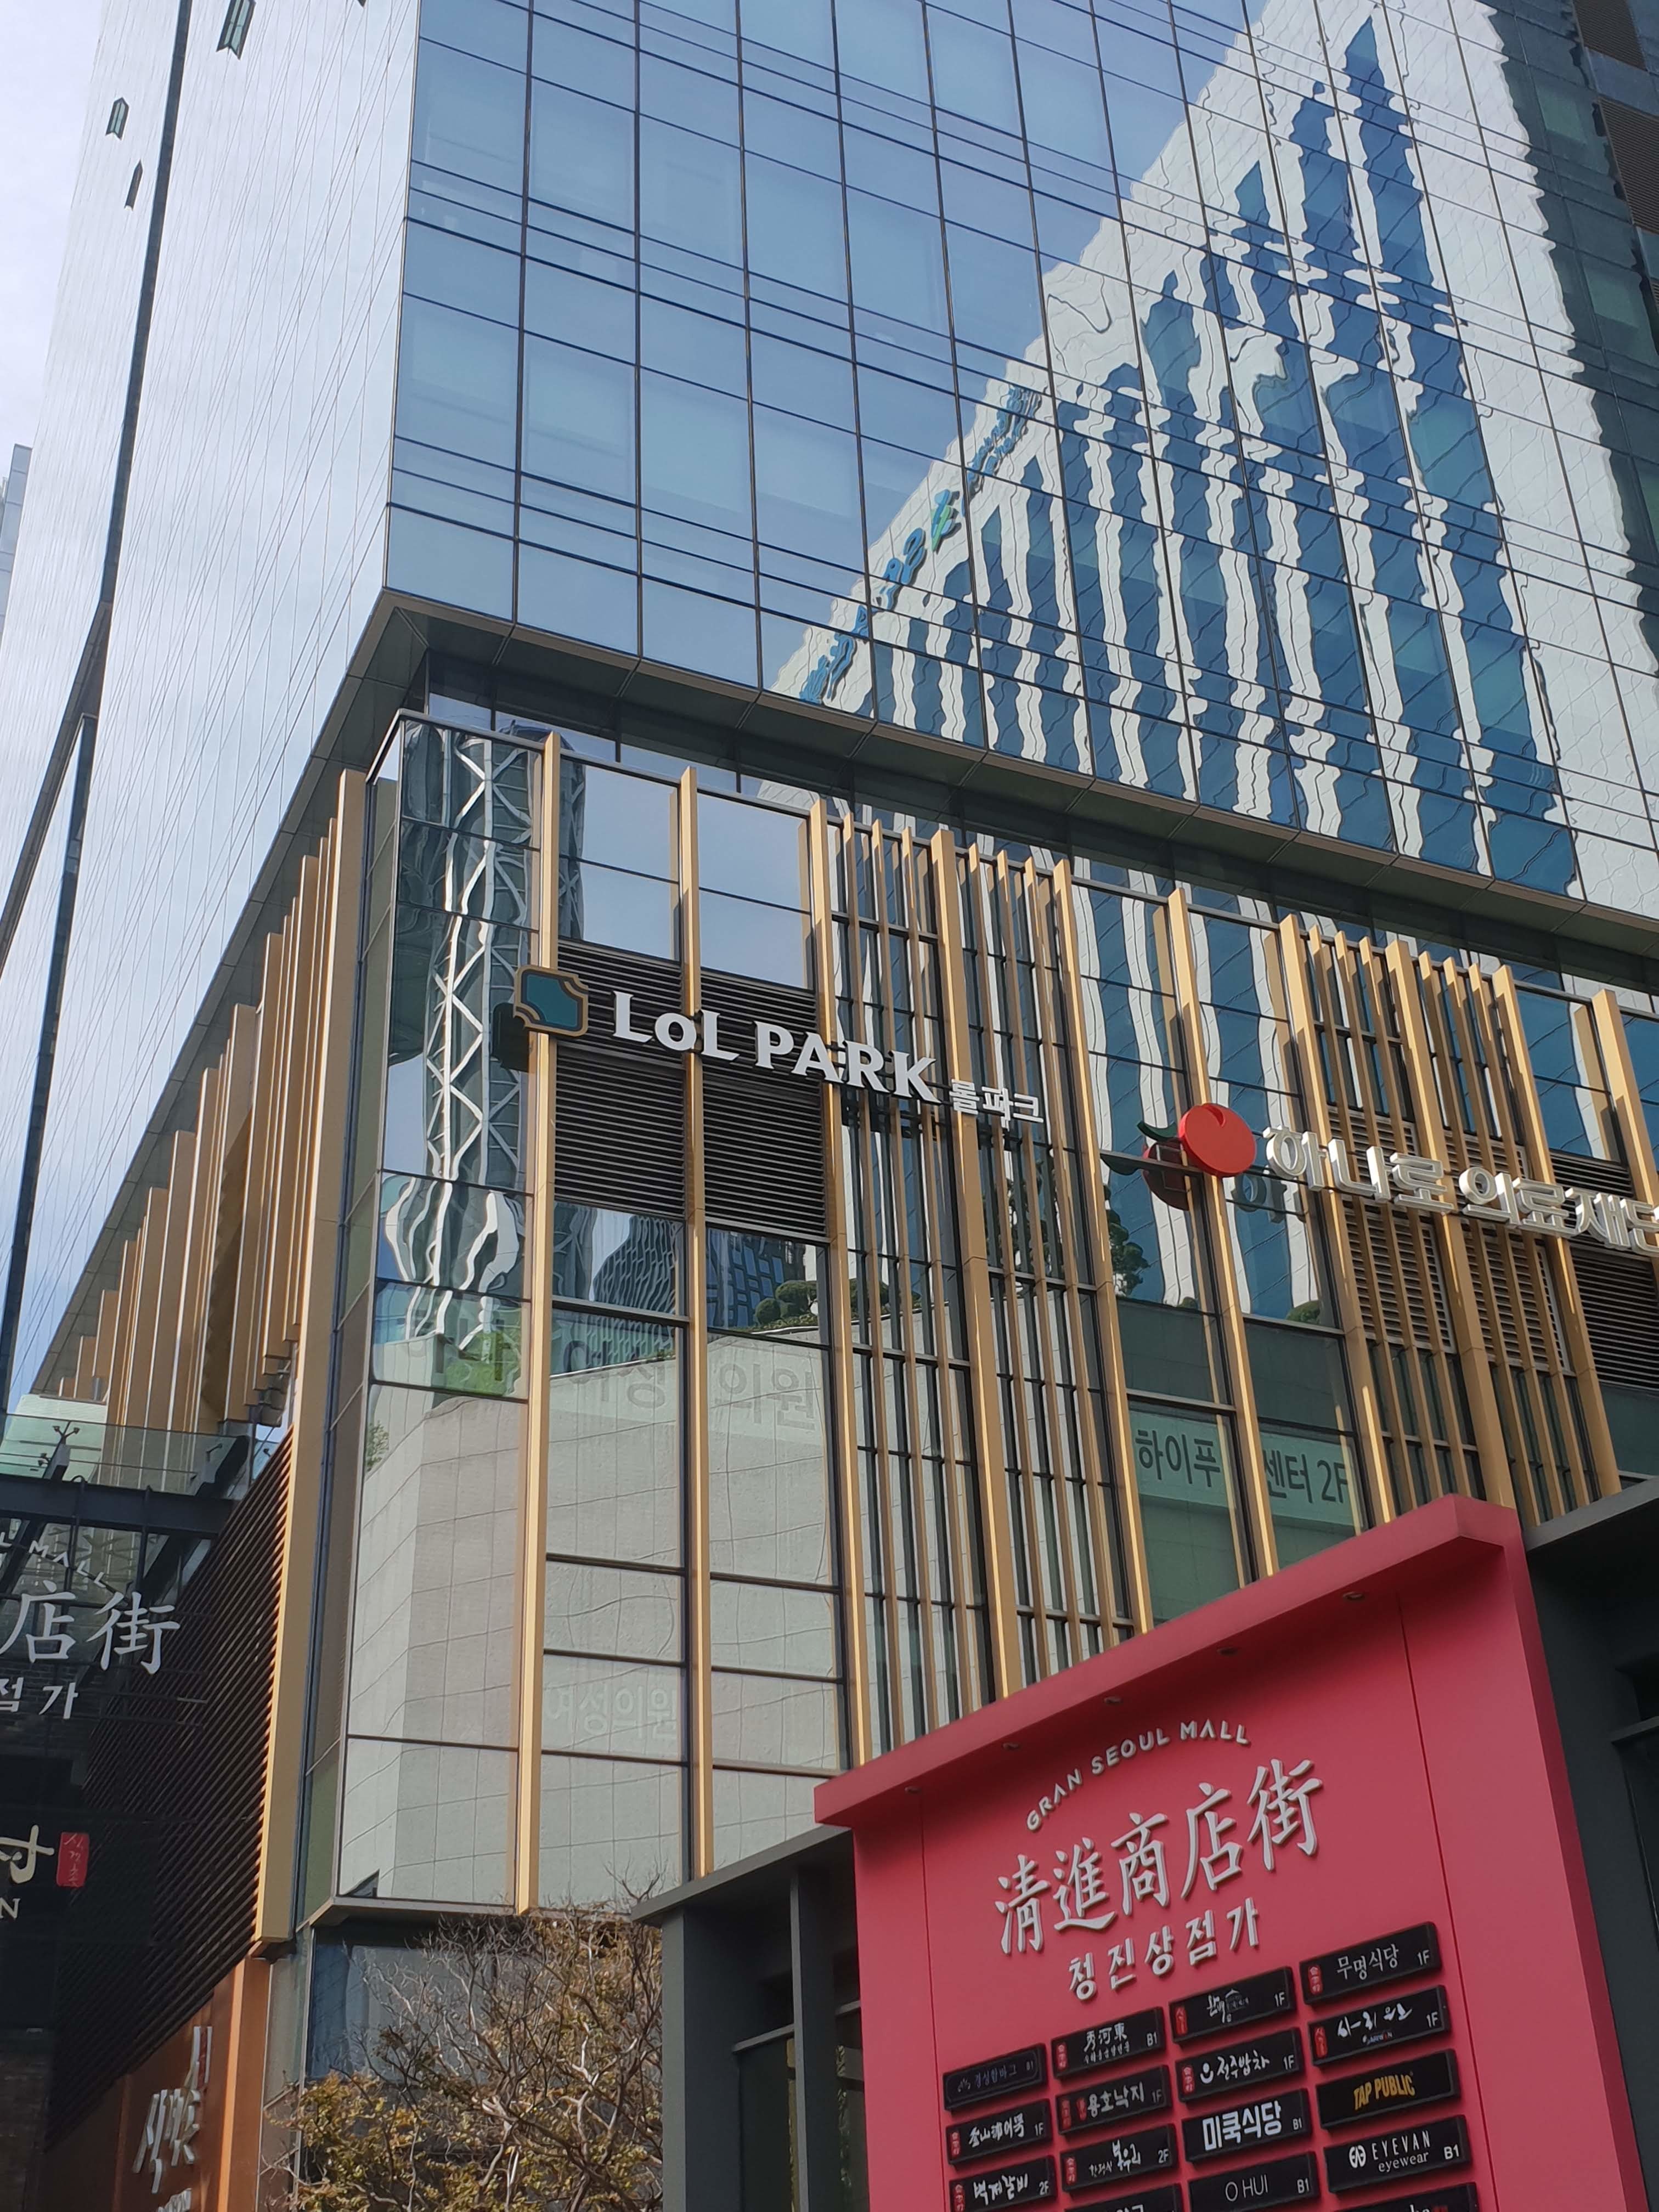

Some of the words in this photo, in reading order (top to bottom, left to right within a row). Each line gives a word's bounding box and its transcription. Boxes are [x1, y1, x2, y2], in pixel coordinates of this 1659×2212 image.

[612, 990, 740, 1062] LoL
[754, 1020, 942, 1104] PARK
[950, 1079, 1045, 1128] 롤파크
[29, 1540, 106, 1589] MALL
[1026, 1768, 1084, 1831] GRAN
[1091, 1726, 1170, 1775] SEOUL
[1180, 1719, 1251, 1746] MALL
[1069, 1897, 1260, 2001] 청진상점가
[1337, 1944, 1399, 1980] 무명식당
[1417, 1950, 1430, 1966] 1F
[1274, 1992, 1285, 2007] 1F
[1426, 2012, 1438, 2028] 1F
[1147, 2032, 1159, 2047] B1
[1216, 2050, 1270, 2080] 전주밥차
[1283, 2055, 1295, 2070] 1F
[1087, 2082, 1145, 2118] 용호낙지
[1152, 2089, 1162, 2103] 1F
[1353, 2082, 1372, 2111] TAP
[1374, 2074, 1415, 2100] PUBLIC
[1035, 2123, 1044, 2137] 1F
[1202, 2100, 1282, 2151] 미쿡식당
[1293, 2118, 1302, 2130] B1
[1158, 2148, 1170, 2164] 2F
[1372, 2130, 1431, 2160] EYEVAN
[1443, 2144, 1460, 2160] B1
[1378, 2151, 1429, 2172] eyewear
[1039, 2180, 1049, 2196] 2F
[1297, 2177, 1310, 2194] B1
